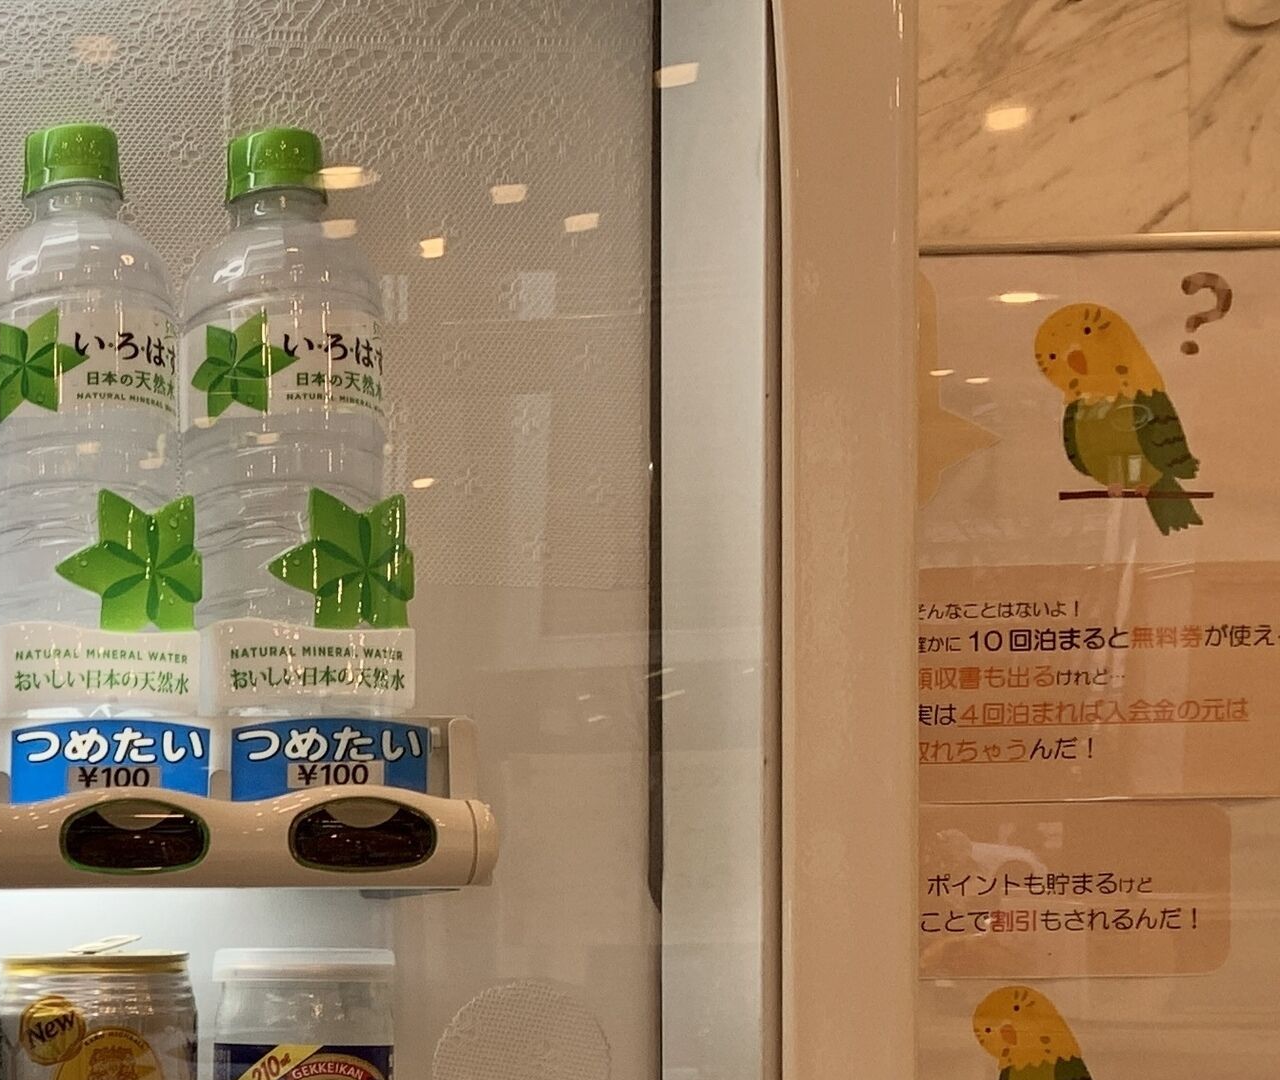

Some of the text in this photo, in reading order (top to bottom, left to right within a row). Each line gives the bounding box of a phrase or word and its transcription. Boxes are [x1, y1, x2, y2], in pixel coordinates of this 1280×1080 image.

[1180, 271, 1233, 356] ?
[968, 630, 1003, 652] 10
[15, 648, 189, 665] NATURAL MINERAL WATER
[76, 766, 152, 790] ¥100
[297, 763, 371, 789] ¥100
[926, 871, 1153, 896] ポイントも貯まるけど
[919, 907, 1201, 932] ことで割引もされるんだ!
[291, 1061, 365, 1080] GEKKEIKAN
